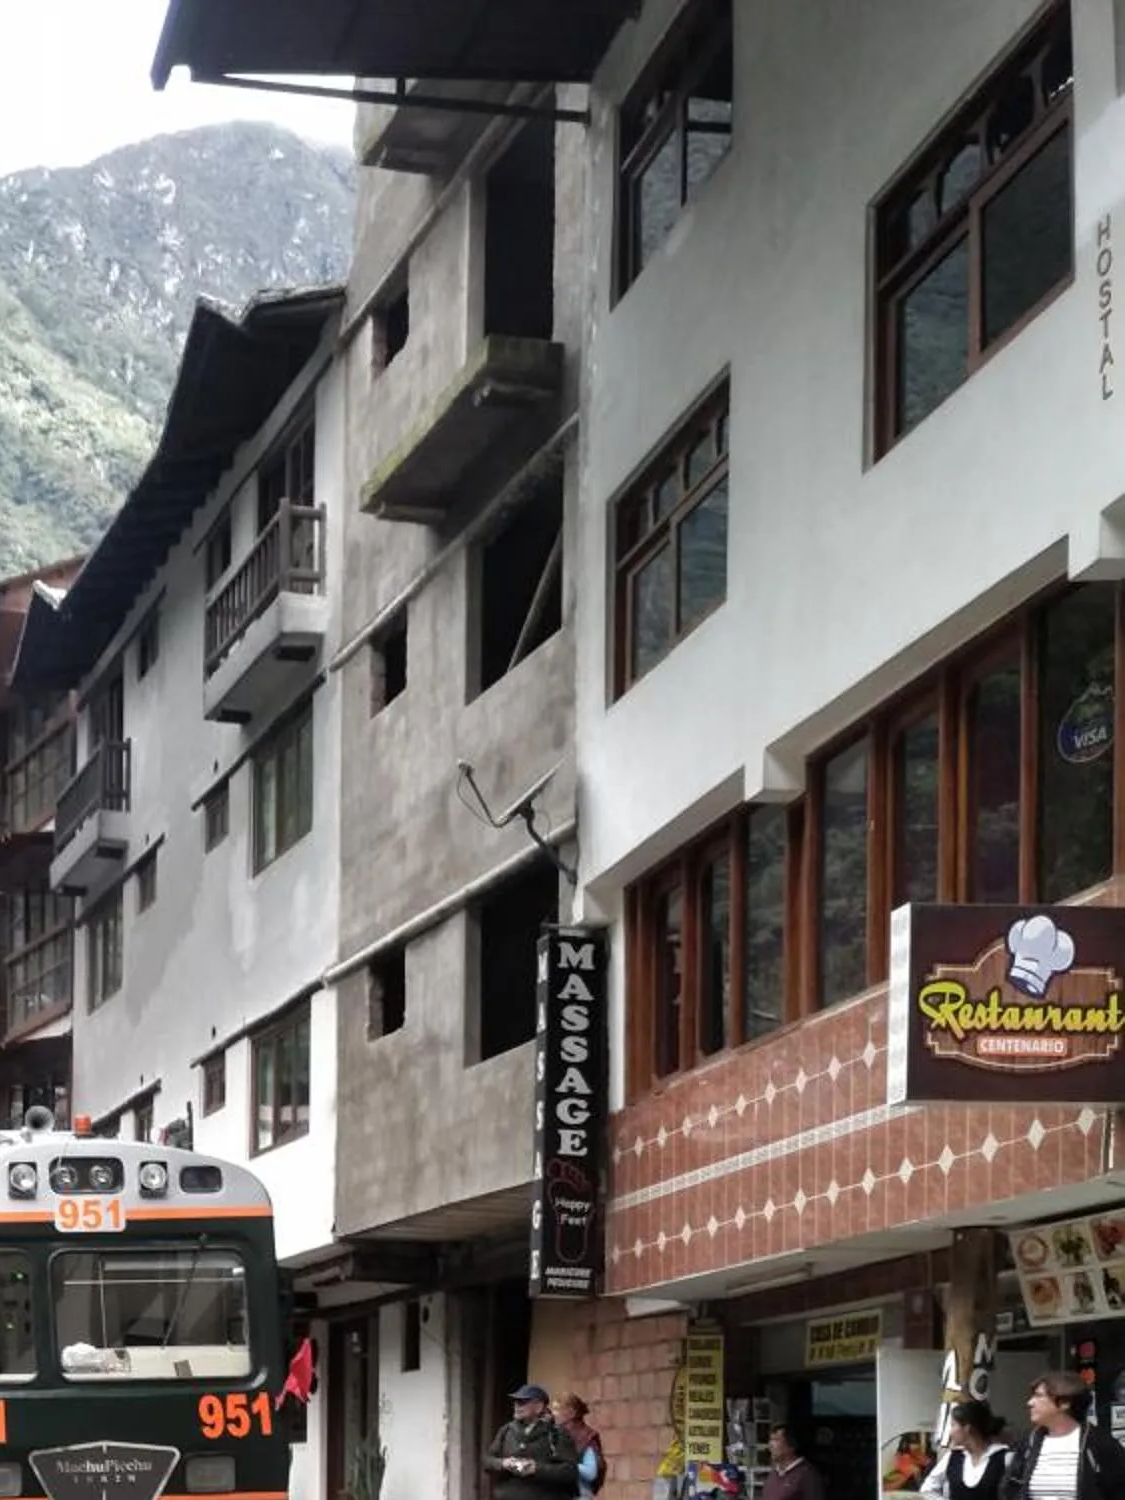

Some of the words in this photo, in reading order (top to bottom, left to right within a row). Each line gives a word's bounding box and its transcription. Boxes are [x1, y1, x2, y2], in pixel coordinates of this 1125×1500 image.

[1096, 213, 1114, 401] HOSTAL
[1074, 726, 1108, 749] VISA
[918, 981, 1125, 1040] Restaurant
[555, 942, 595, 1157] MASSAGE
[979, 1038, 1065, 1053] CENTENARIO
[530, 951, 548, 1280] MASSAGE
[58, 1199, 122, 1229] 951
[555, 1197, 592, 1213] Happy
[198, 1391, 273, 1439] 951
